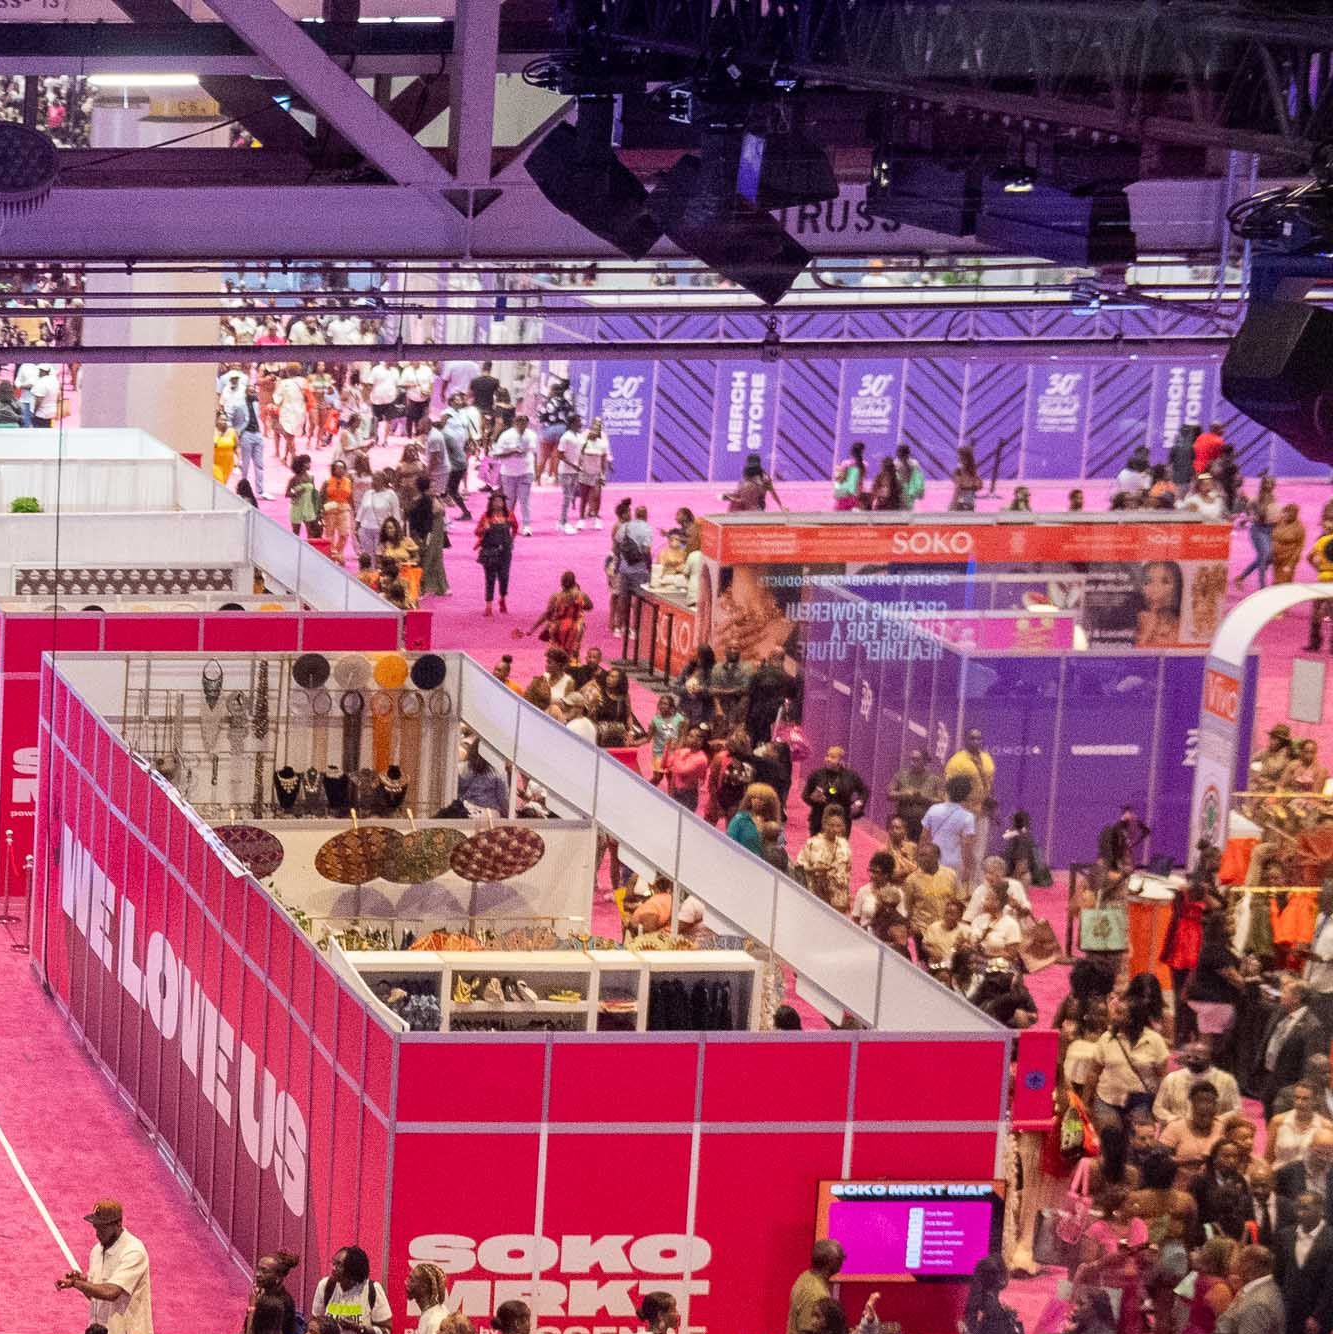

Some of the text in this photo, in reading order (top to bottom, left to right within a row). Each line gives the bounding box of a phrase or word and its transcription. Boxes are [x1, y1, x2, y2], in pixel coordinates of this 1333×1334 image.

[727, 370, 747, 451] MERCH
[746, 372, 767, 450] STORE
[1184, 368, 1205, 426] TORE
[893, 531, 974, 554] SOKO
[61, 822, 309, 1217] WE LOVE US
[830, 1183, 994, 1197] SOKO MRKT MAP
[407, 1233, 712, 1275] SOKO
[406, 1280, 710, 1319] MRKT
